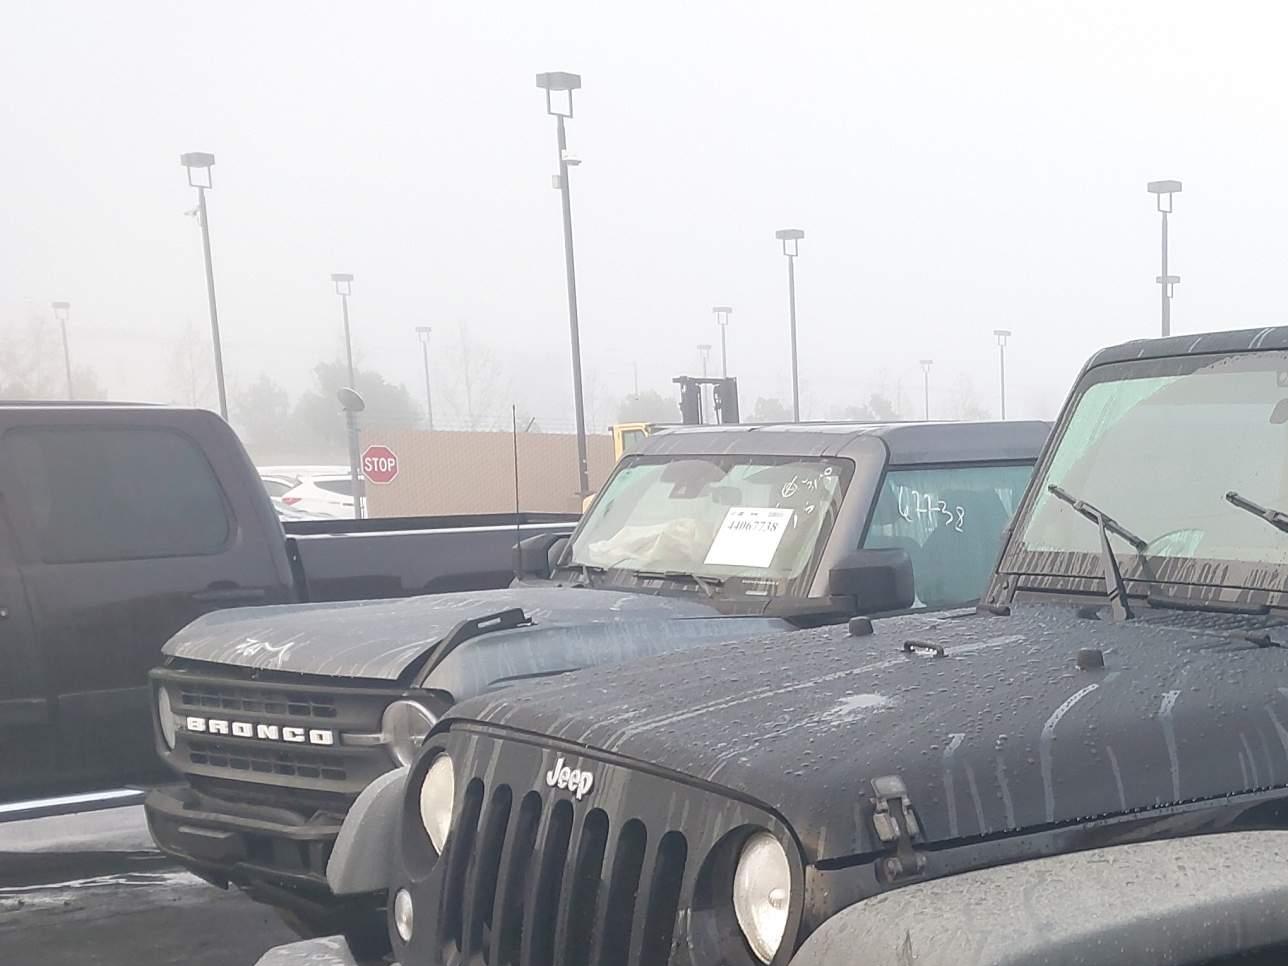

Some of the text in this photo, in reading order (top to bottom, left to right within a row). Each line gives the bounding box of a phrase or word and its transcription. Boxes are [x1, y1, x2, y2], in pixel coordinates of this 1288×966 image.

[364, 457, 395, 472] STOP
[186, 716, 334, 745] BRONCO
[546, 757, 593, 800] Jeep
